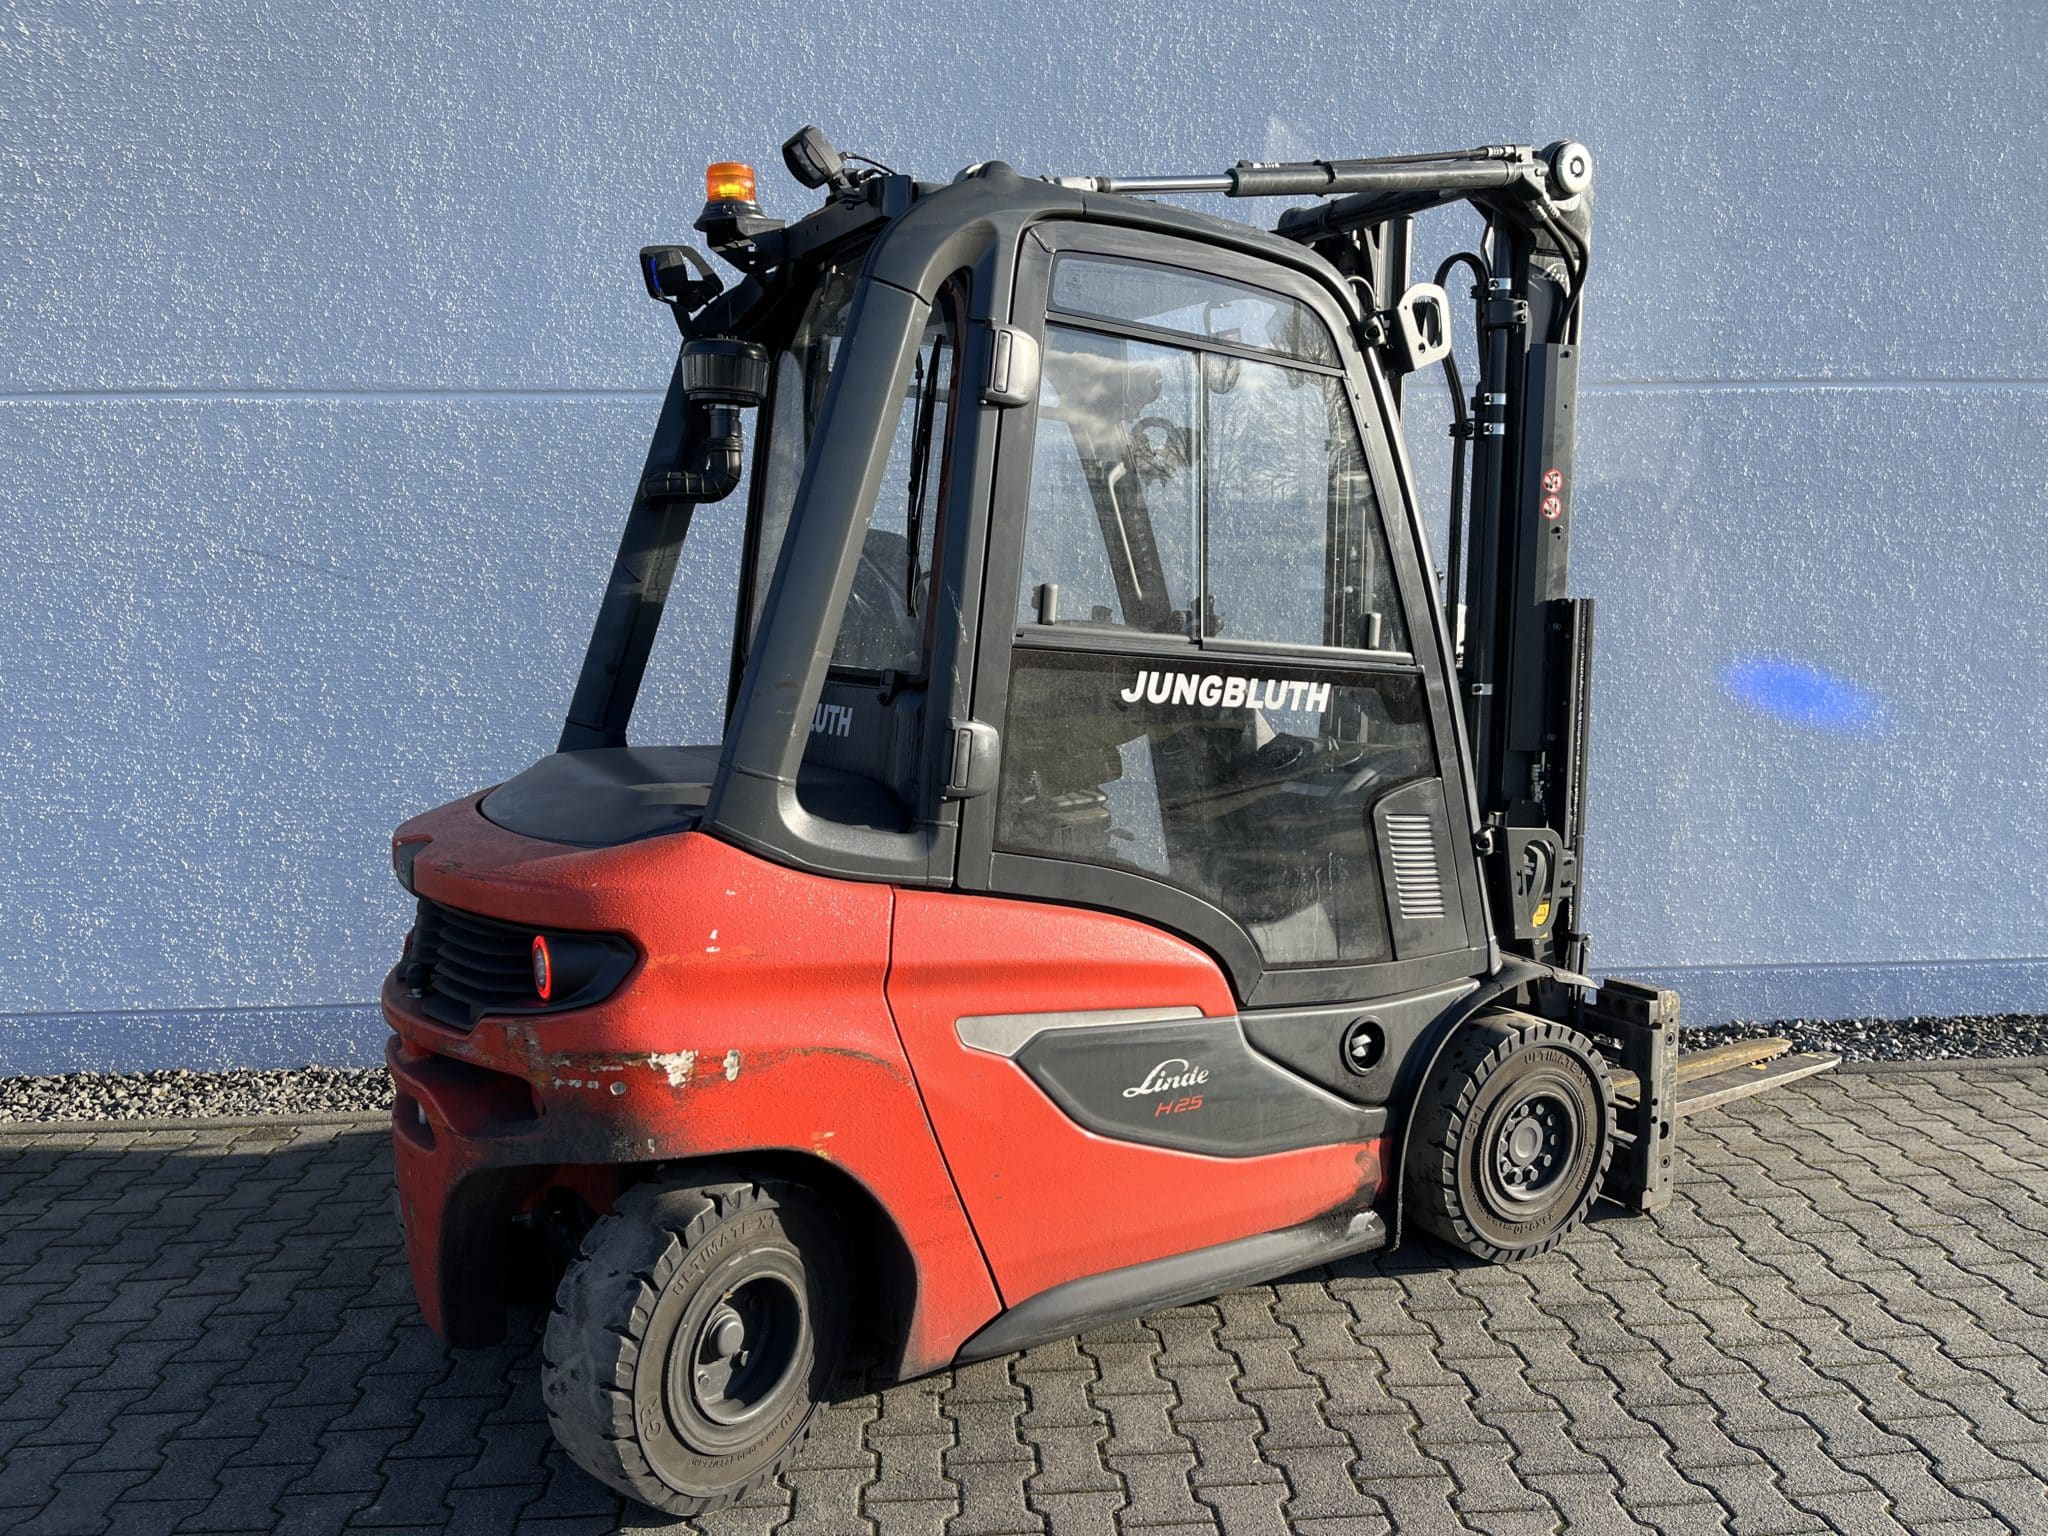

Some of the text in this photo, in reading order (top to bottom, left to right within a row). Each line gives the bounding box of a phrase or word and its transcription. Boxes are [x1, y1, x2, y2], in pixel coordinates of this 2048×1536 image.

[1120, 670, 1331, 713] JUNGBLUTH
[811, 703, 853, 737] UTH
[1122, 1058, 1209, 1098] Linde
